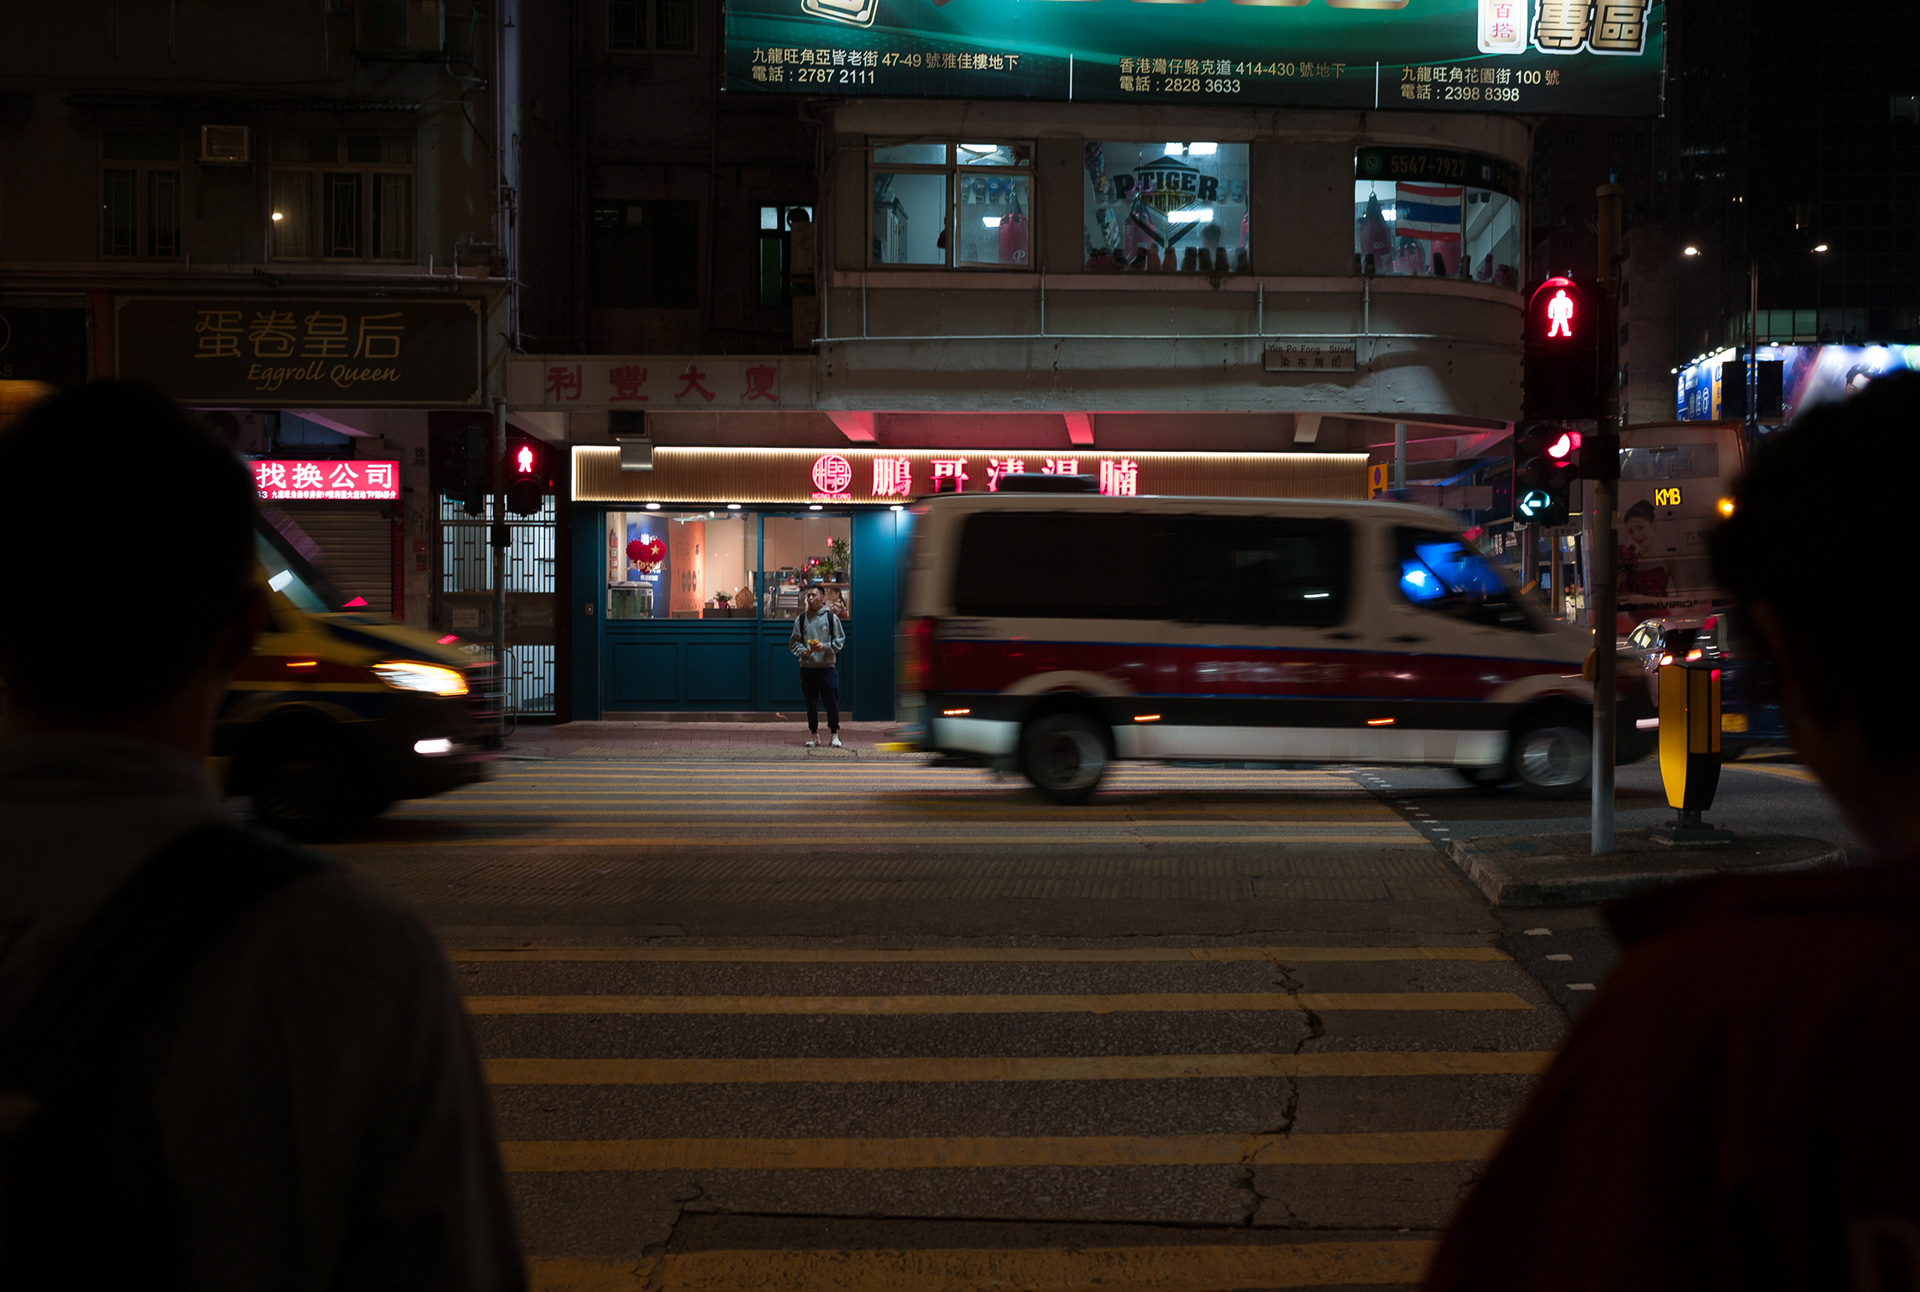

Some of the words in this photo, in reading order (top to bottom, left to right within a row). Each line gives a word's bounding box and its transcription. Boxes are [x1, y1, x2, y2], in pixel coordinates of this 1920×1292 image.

[1491, 3, 1514, 39] 百搭
[752, 47, 879, 67] 九龍旺角亞皆老街
[882, 52, 922, 68] 47-49
[925, 52, 1020, 71] 號雅佳樓地下
[1119, 57, 1232, 76] 香港灣仔駱克道
[1235, 61, 1295, 76] 414-430
[1298, 61, 1346, 78] 號地下
[798, 68, 833, 83] 2787
[839, 69, 876, 84] 2111
[1164, 78, 1201, 93] 2828
[1204, 79, 1241, 93] 3633
[1401, 65, 1511, 85] 九龍旺角花園街
[1515, 69, 1542, 85] 100
[1544, 69, 1561, 86] 號
[1444, 86, 1480, 101] 2398
[1484, 87, 1520, 102] 8398
[1390, 154, 1466, 178] 5547-7927
[194, 309, 405, 360] 蛋卷皇后
[1268, 344, 1283, 353] Yim
[1286, 344, 1297, 353] Po
[1300, 344, 1321, 355] Fong
[1329, 345, 1352, 354] Street
[246, 360, 326, 391] Eggroll
[330, 363, 401, 389] Queen
[545, 364, 779, 402] 利豐大廈
[812, 492, 831, 500] HONG
[832, 492, 852, 500] KONG
[1655, 487, 1681, 506] KMB
